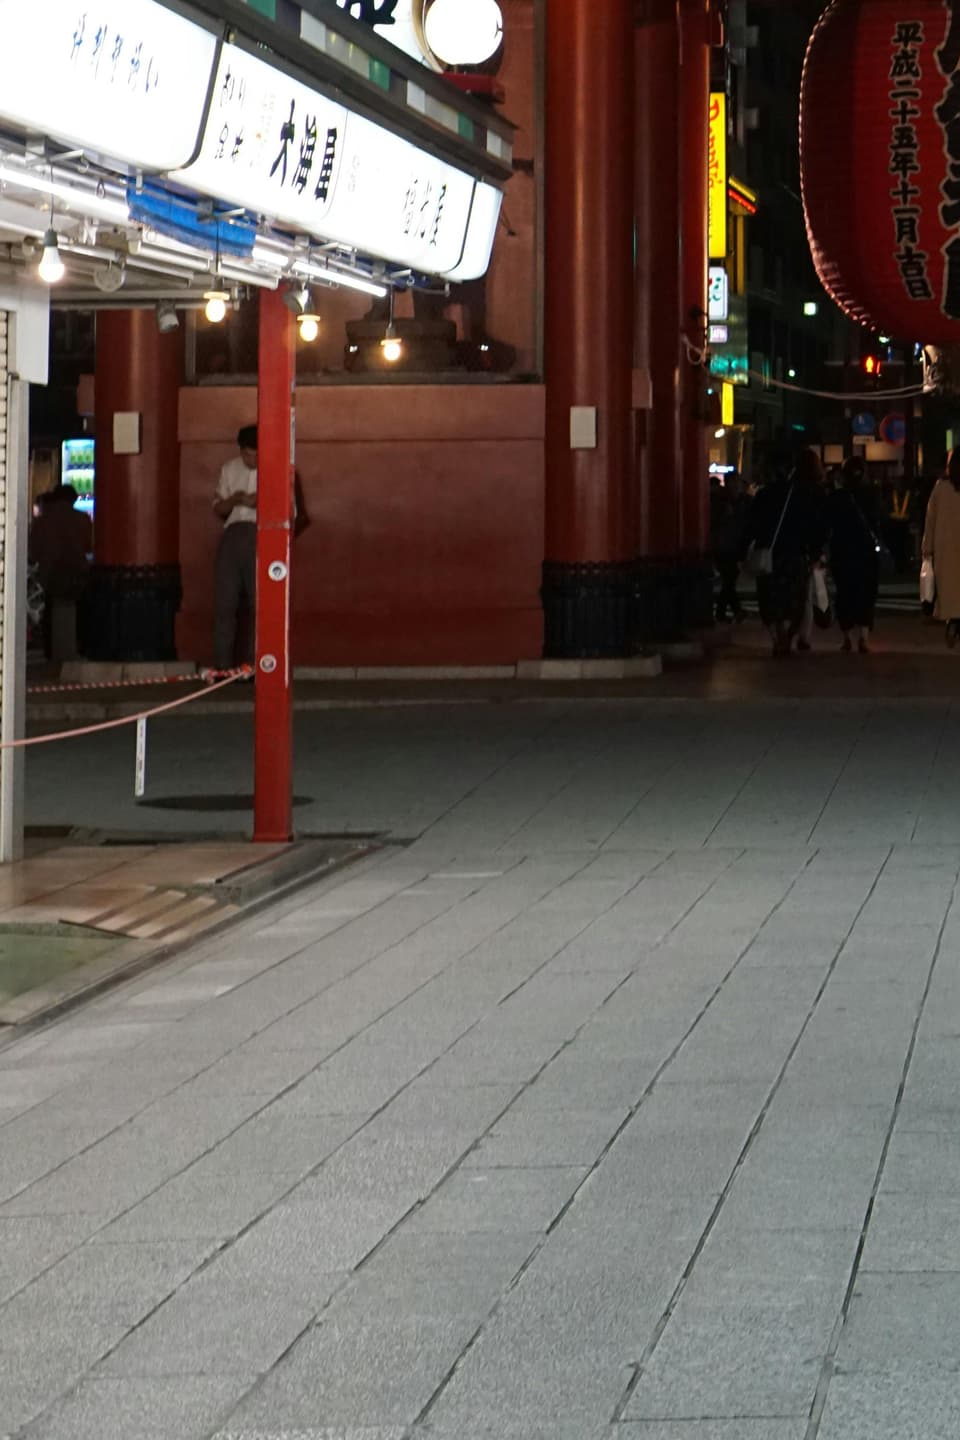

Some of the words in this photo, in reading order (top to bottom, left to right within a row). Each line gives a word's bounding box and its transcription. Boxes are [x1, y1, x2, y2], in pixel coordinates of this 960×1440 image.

[887, 21, 935, 301] 平成二十五年十一月吉日
